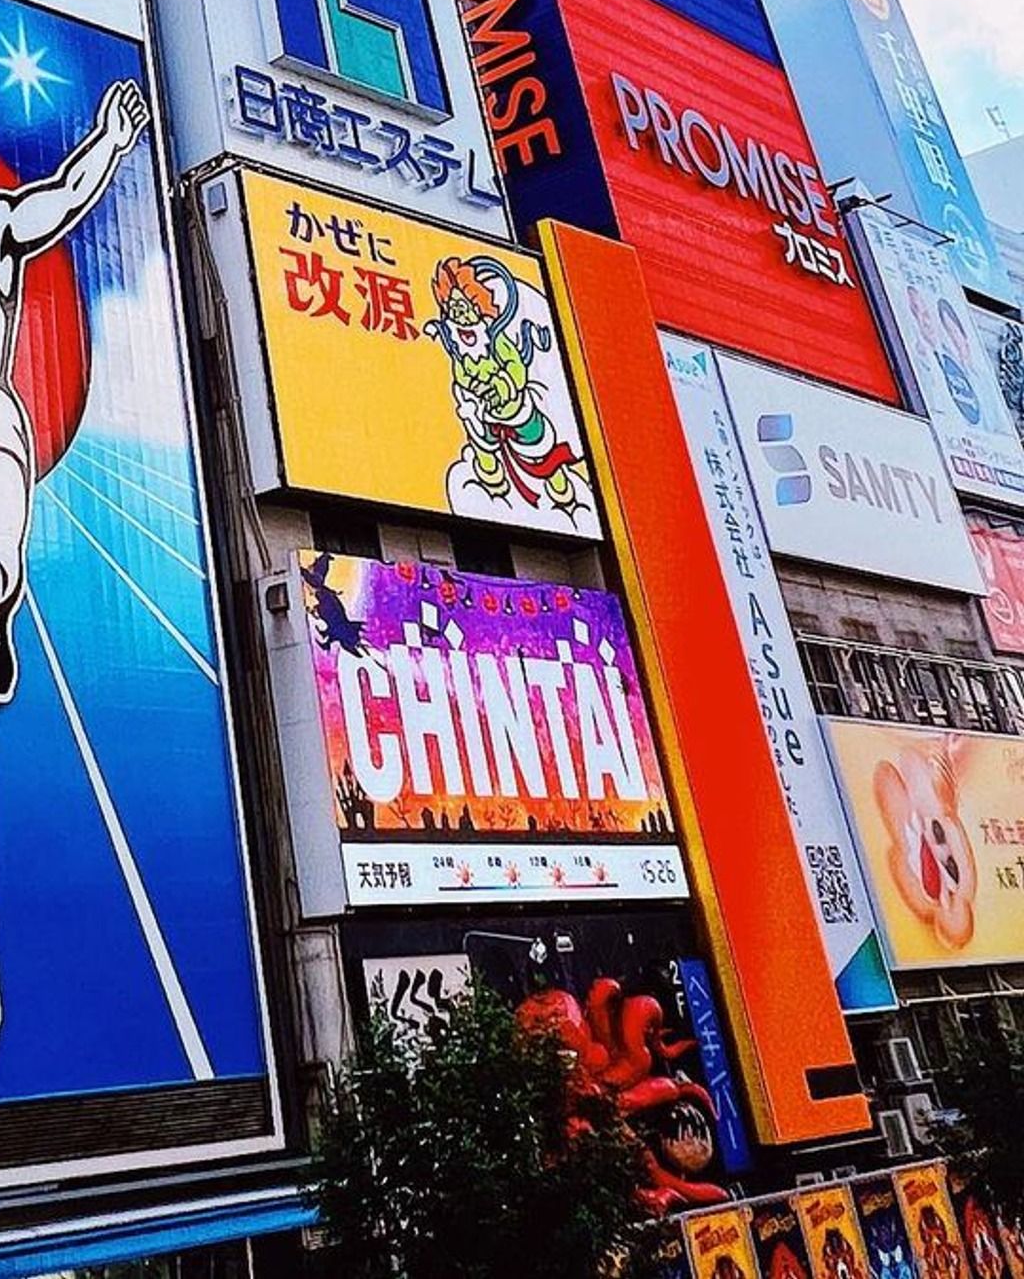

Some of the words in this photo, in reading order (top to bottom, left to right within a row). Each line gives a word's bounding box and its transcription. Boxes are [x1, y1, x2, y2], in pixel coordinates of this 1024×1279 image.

[609, 70, 840, 239] PROMISE
[286, 200, 396, 266] かぜに
[774, 220, 856, 289] プロミス
[279, 246, 420, 342] 改源
[818, 444, 943, 524] SAMTY
[337, 639, 647, 802] CHINTAI
